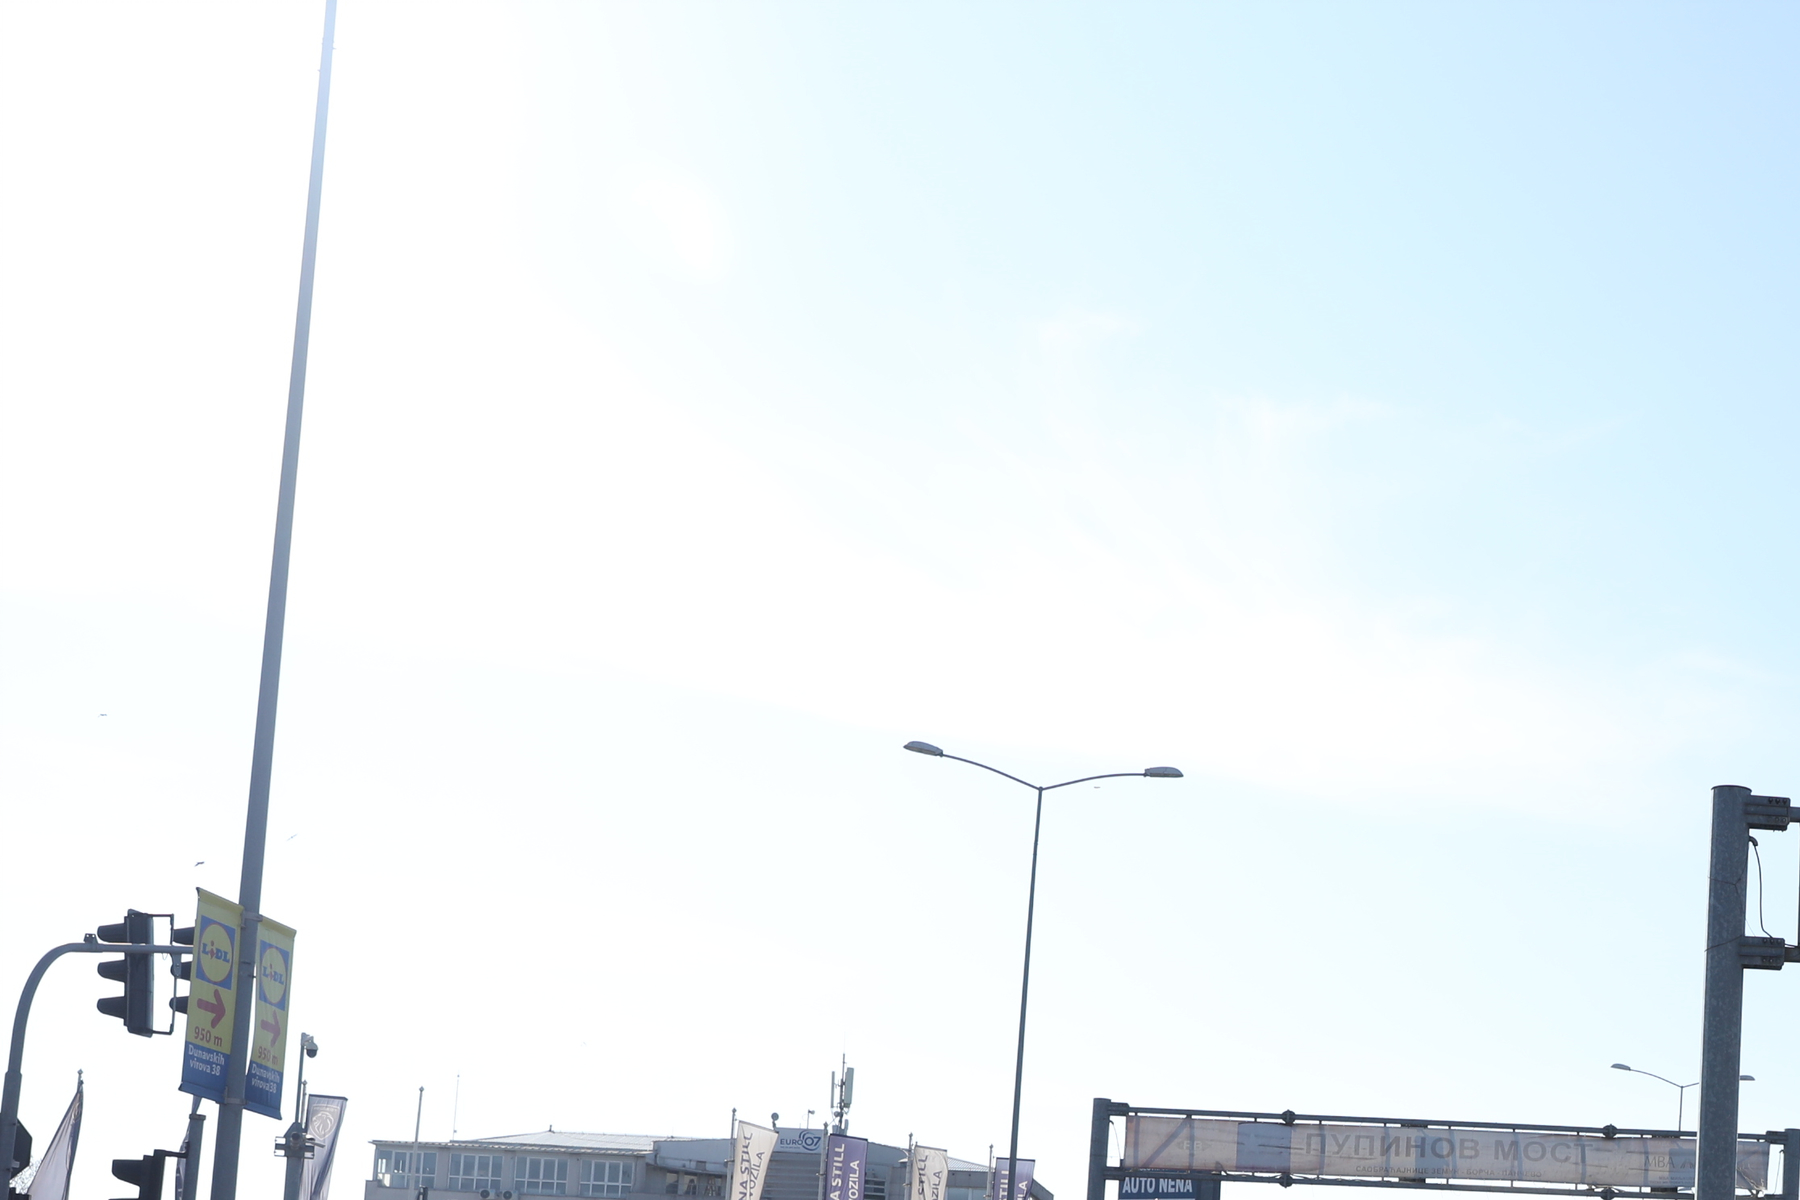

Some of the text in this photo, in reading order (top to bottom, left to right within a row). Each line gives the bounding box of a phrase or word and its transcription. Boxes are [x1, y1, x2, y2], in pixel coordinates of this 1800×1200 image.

[201, 940, 230, 963] LIDL
[262, 963, 285, 985] LIDL
[194, 1026, 222, 1047] 950 m
[188, 1045, 225, 1066] Dunavskih
[257, 1046, 279, 1065] 950 m
[190, 1057, 221, 1076] virova 38
[251, 1064, 280, 1083] Dunavskih
[251, 1076, 277, 1094] virova 38
[780, 1136, 821, 1147] EURO 07
[1304, 1132, 1594, 1165] ПУПИНОВ МОСТ
[831, 1143, 845, 1187] STILL
[1355, 1165, 1430, 1175] САОБРАЋАЈНИЦЕ
[1466, 1168, 1496, 1177] БОРЧА
[917, 1155, 928, 1198] STILL
[1122, 1177, 1193, 1194] AUTO NENA
